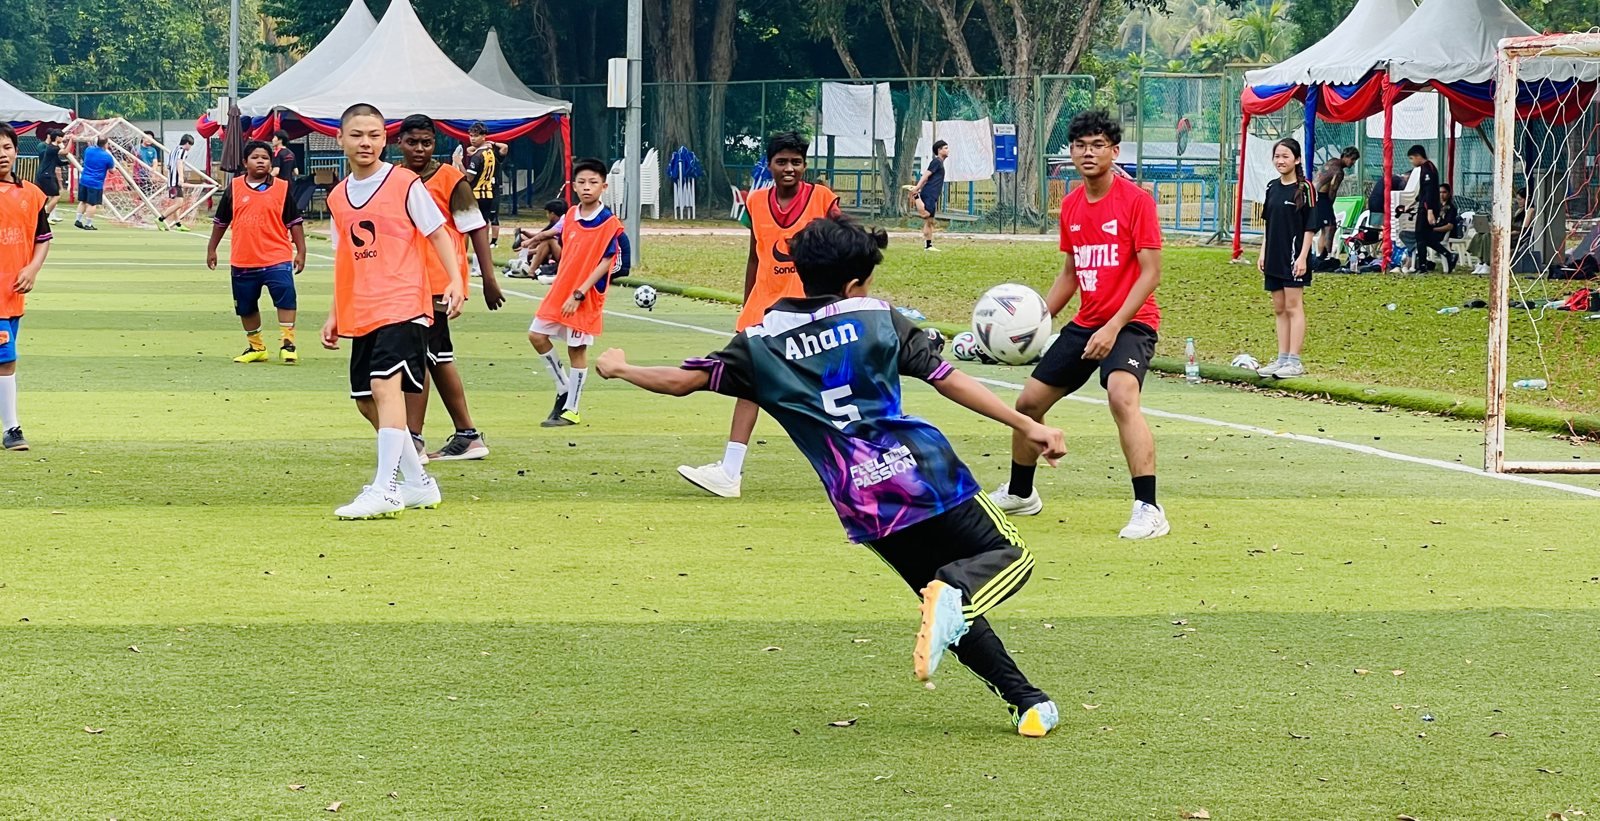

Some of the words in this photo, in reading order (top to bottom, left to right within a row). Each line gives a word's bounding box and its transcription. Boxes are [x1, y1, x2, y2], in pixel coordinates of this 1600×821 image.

[785, 322, 859, 361] Ahan
[820, 384, 862, 430] 5
[850, 457, 886, 479] FEEL
[852, 453, 918, 491] PASSION
